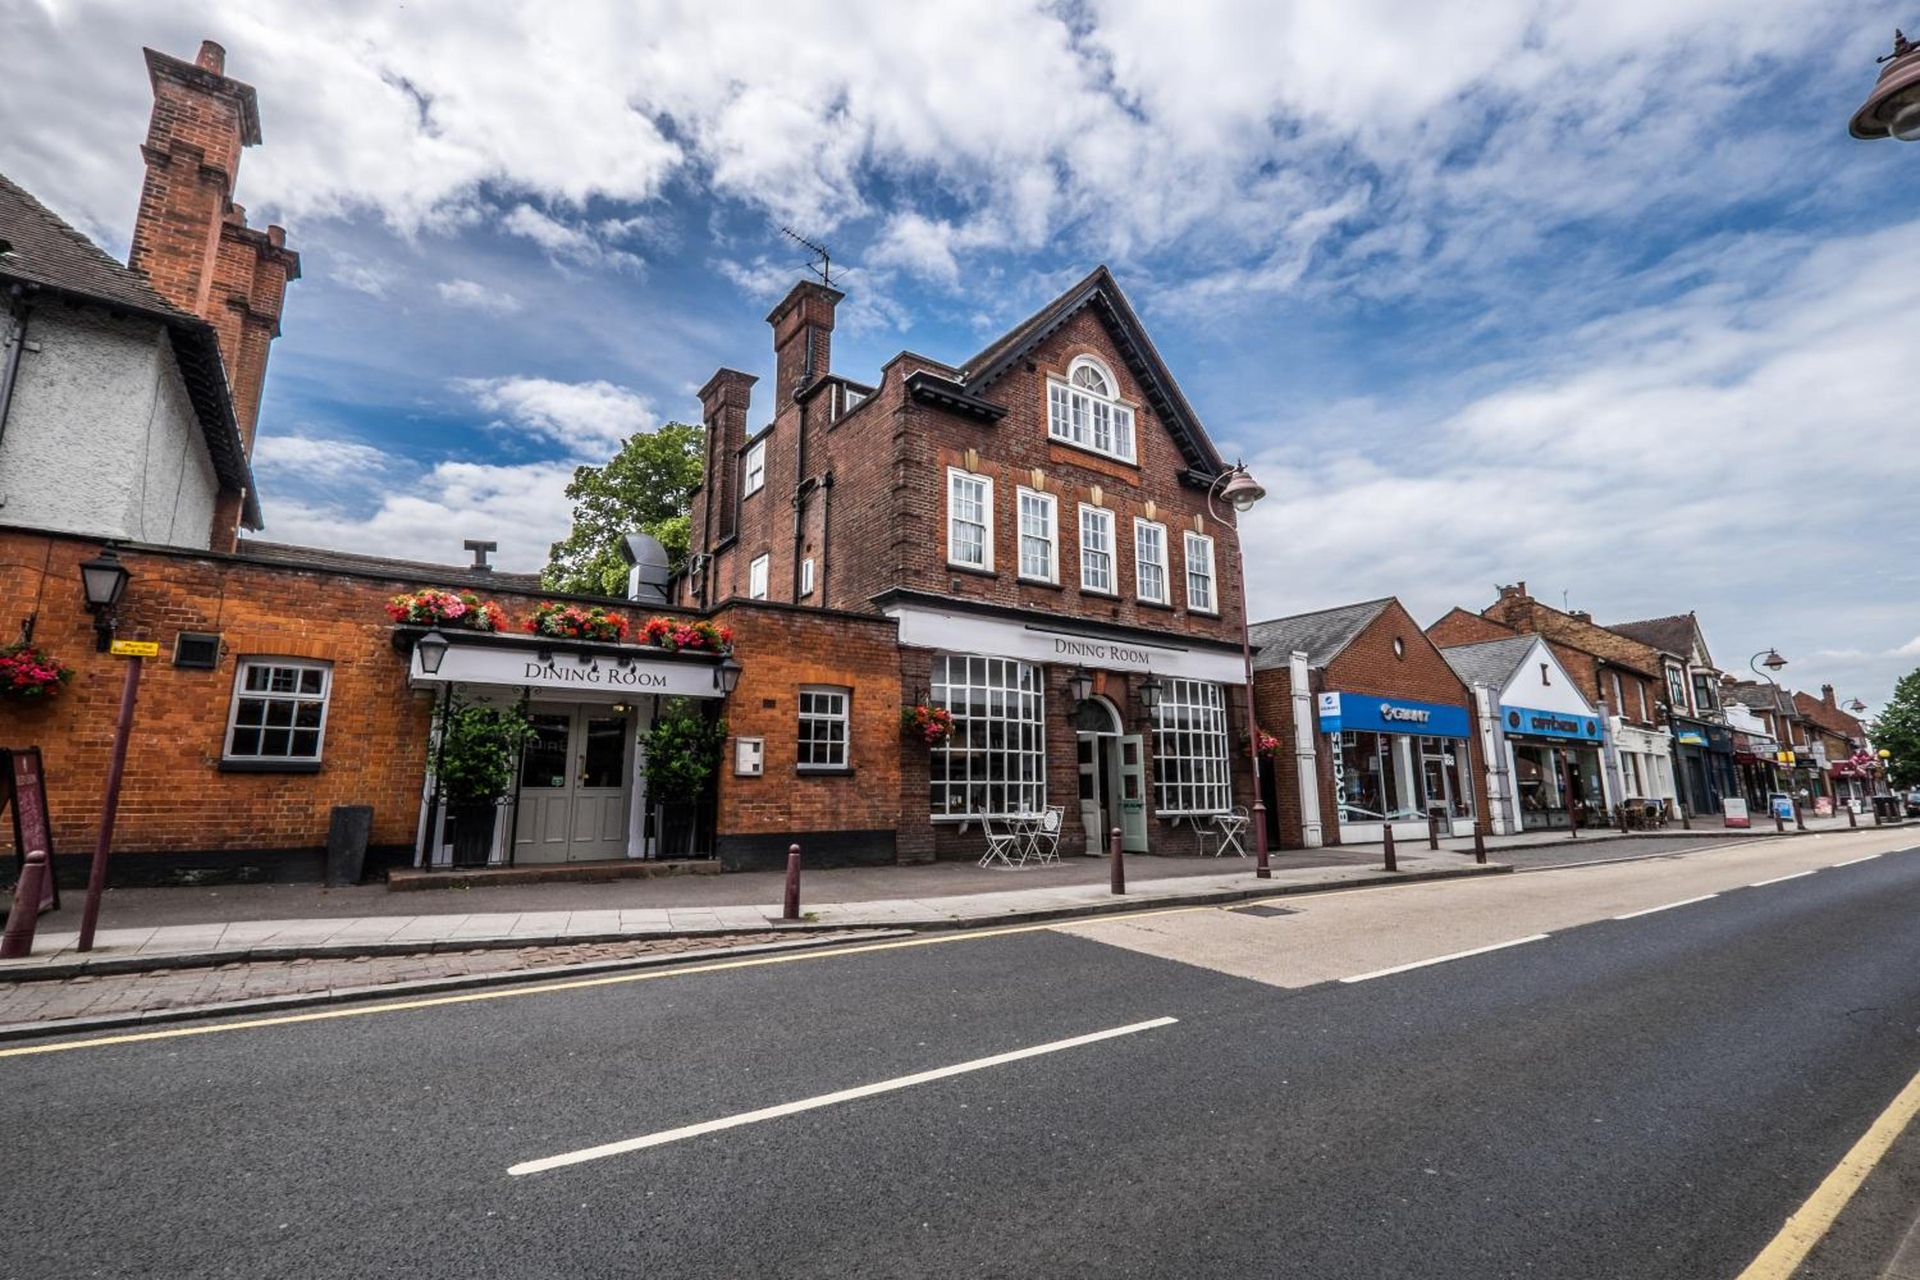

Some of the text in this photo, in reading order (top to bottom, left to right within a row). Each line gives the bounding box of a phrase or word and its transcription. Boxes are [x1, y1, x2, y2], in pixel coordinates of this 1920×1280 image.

[1055, 638, 1149, 665] DINING ROOM
[525, 662, 667, 687] DINING ROOM
[1393, 706, 1431, 722] GIANT
[1331, 731, 1349, 824] BICYCLES
